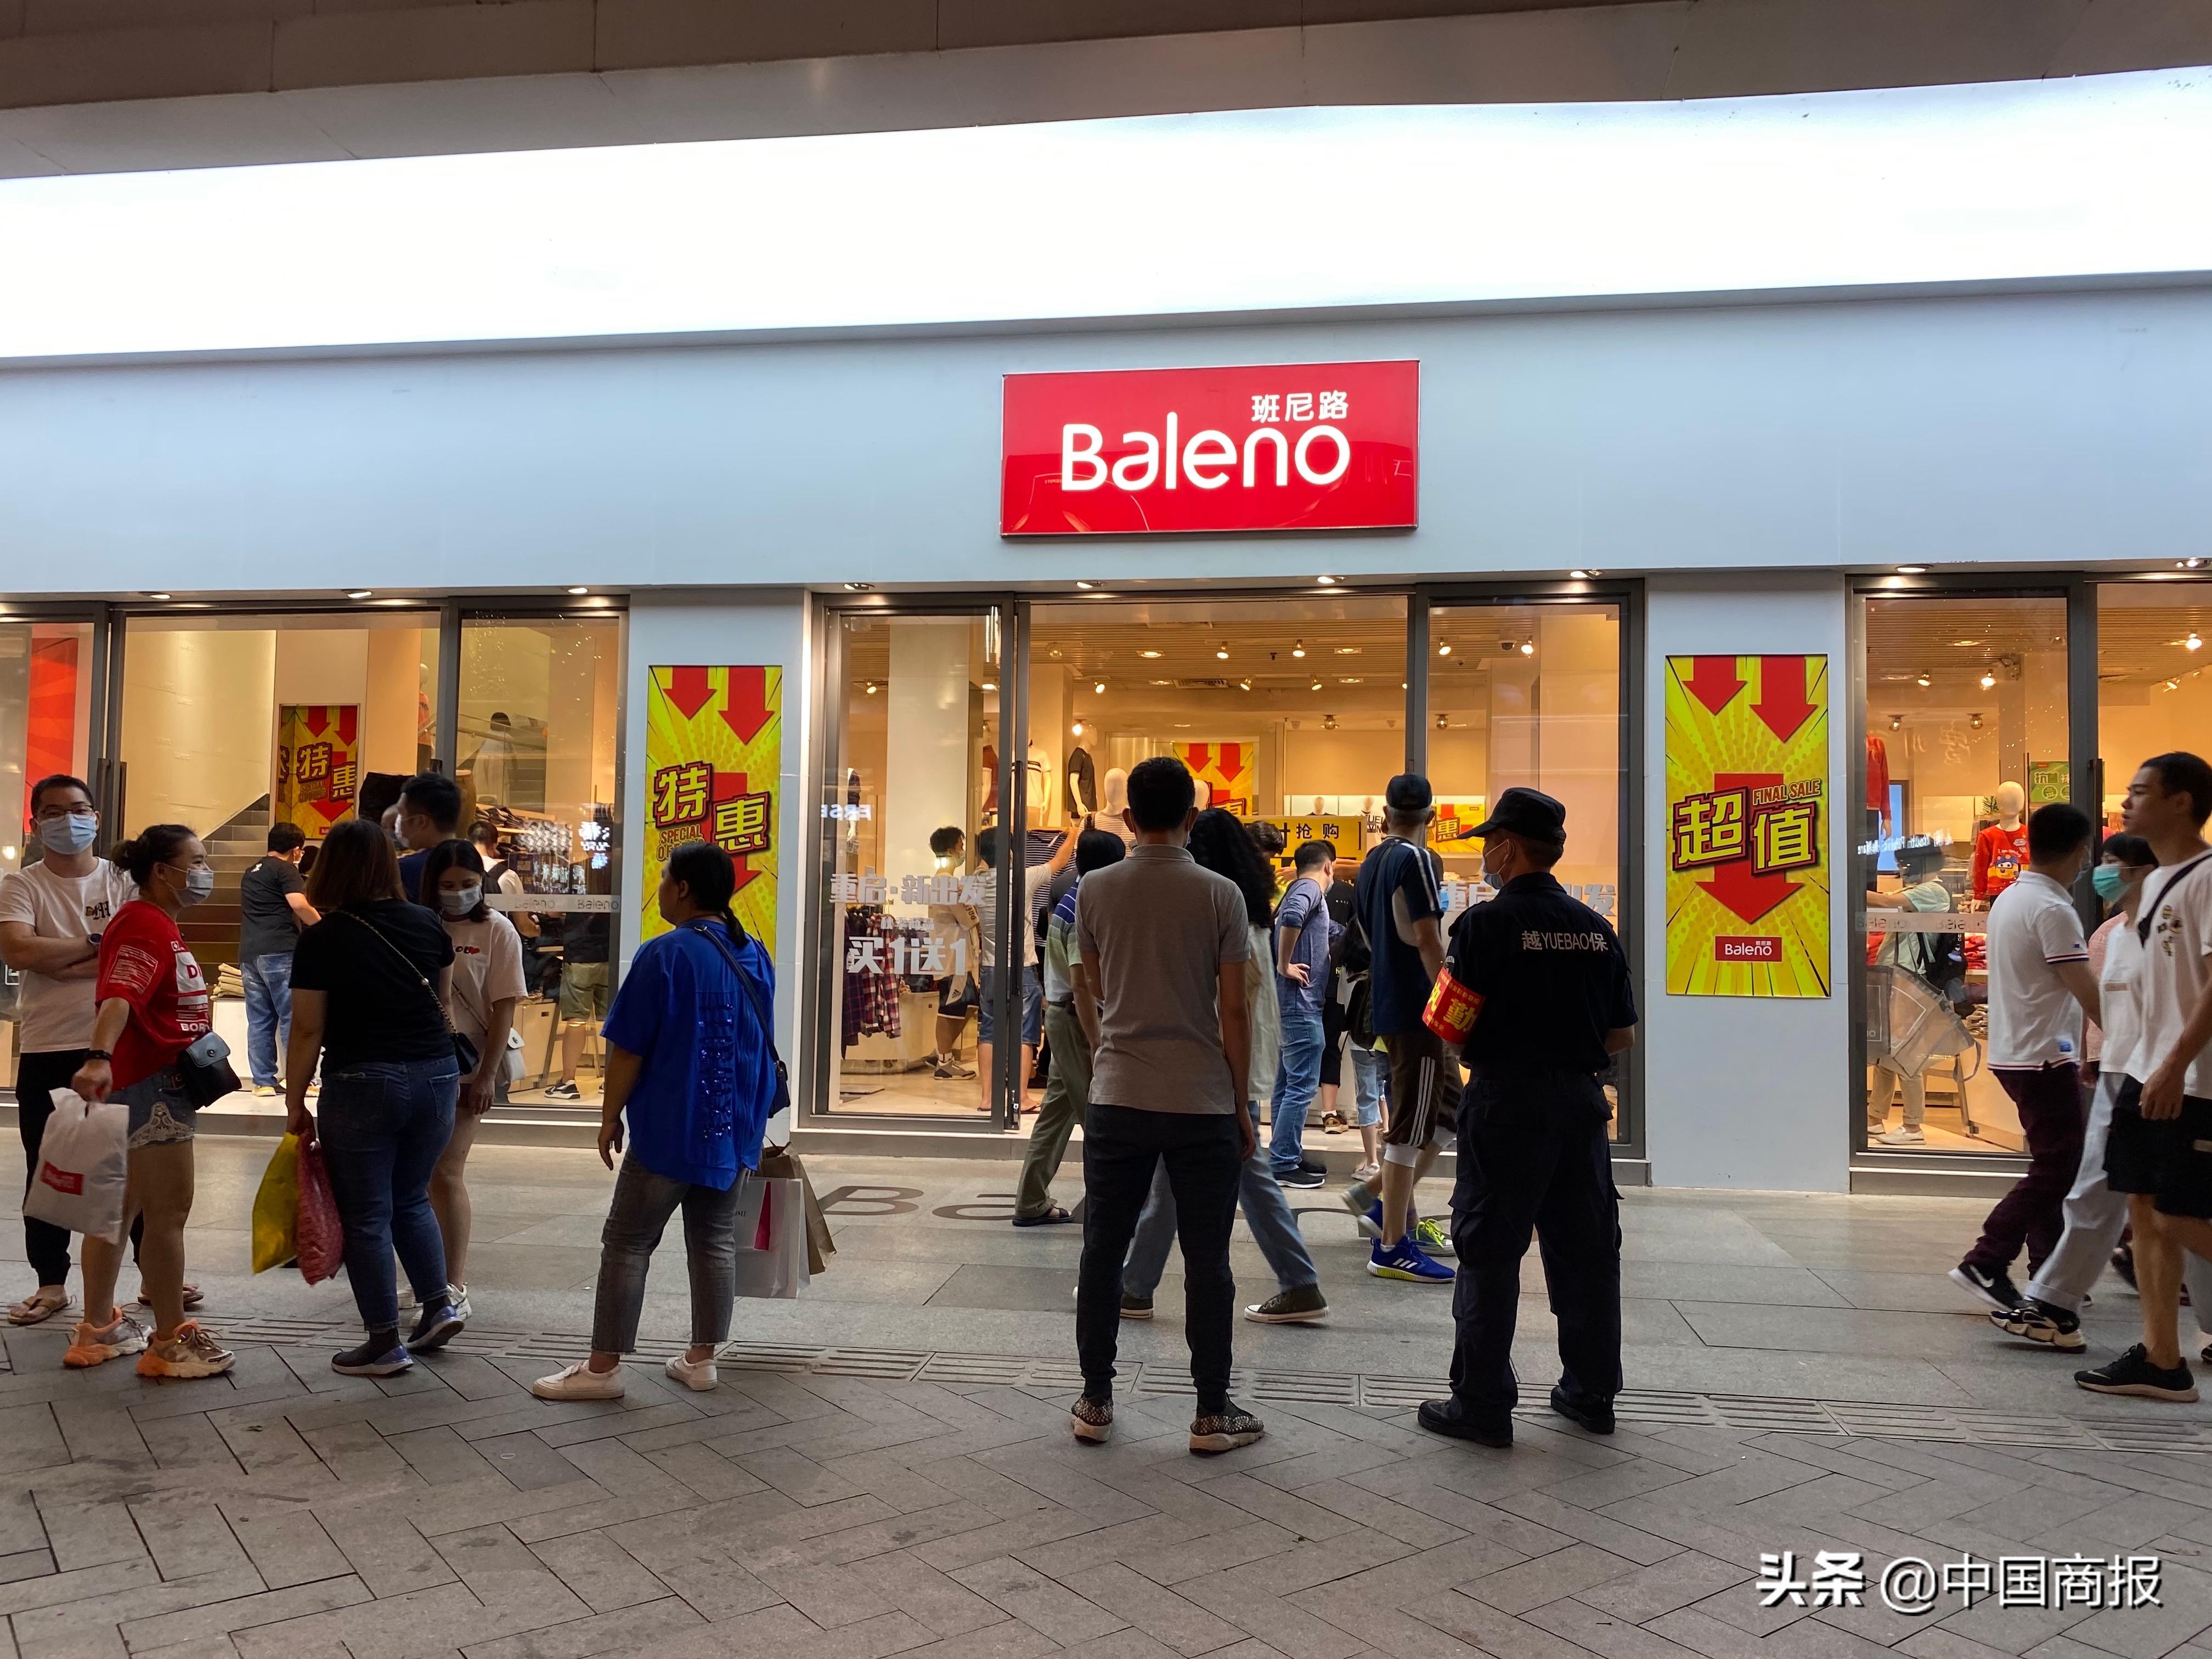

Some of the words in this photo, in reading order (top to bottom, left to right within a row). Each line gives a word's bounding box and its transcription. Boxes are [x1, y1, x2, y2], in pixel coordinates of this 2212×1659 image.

[1251, 390, 1349, 424] 班尼路
[1061, 411, 1351, 492] Baleno
[1753, 785, 1788, 806] FINAL
[1790, 780, 1821, 799] SALE
[655, 764, 768, 853] 特惠
[660, 824, 702, 844] SPECIAL
[1675, 789, 1814, 873] 超值
[577, 898, 619, 910] Baleno
[847, 936, 966, 976] 买1送1
[1521, 930, 1609, 952] 越YUEBAO保
[1725, 943, 1773, 956] Baleno
